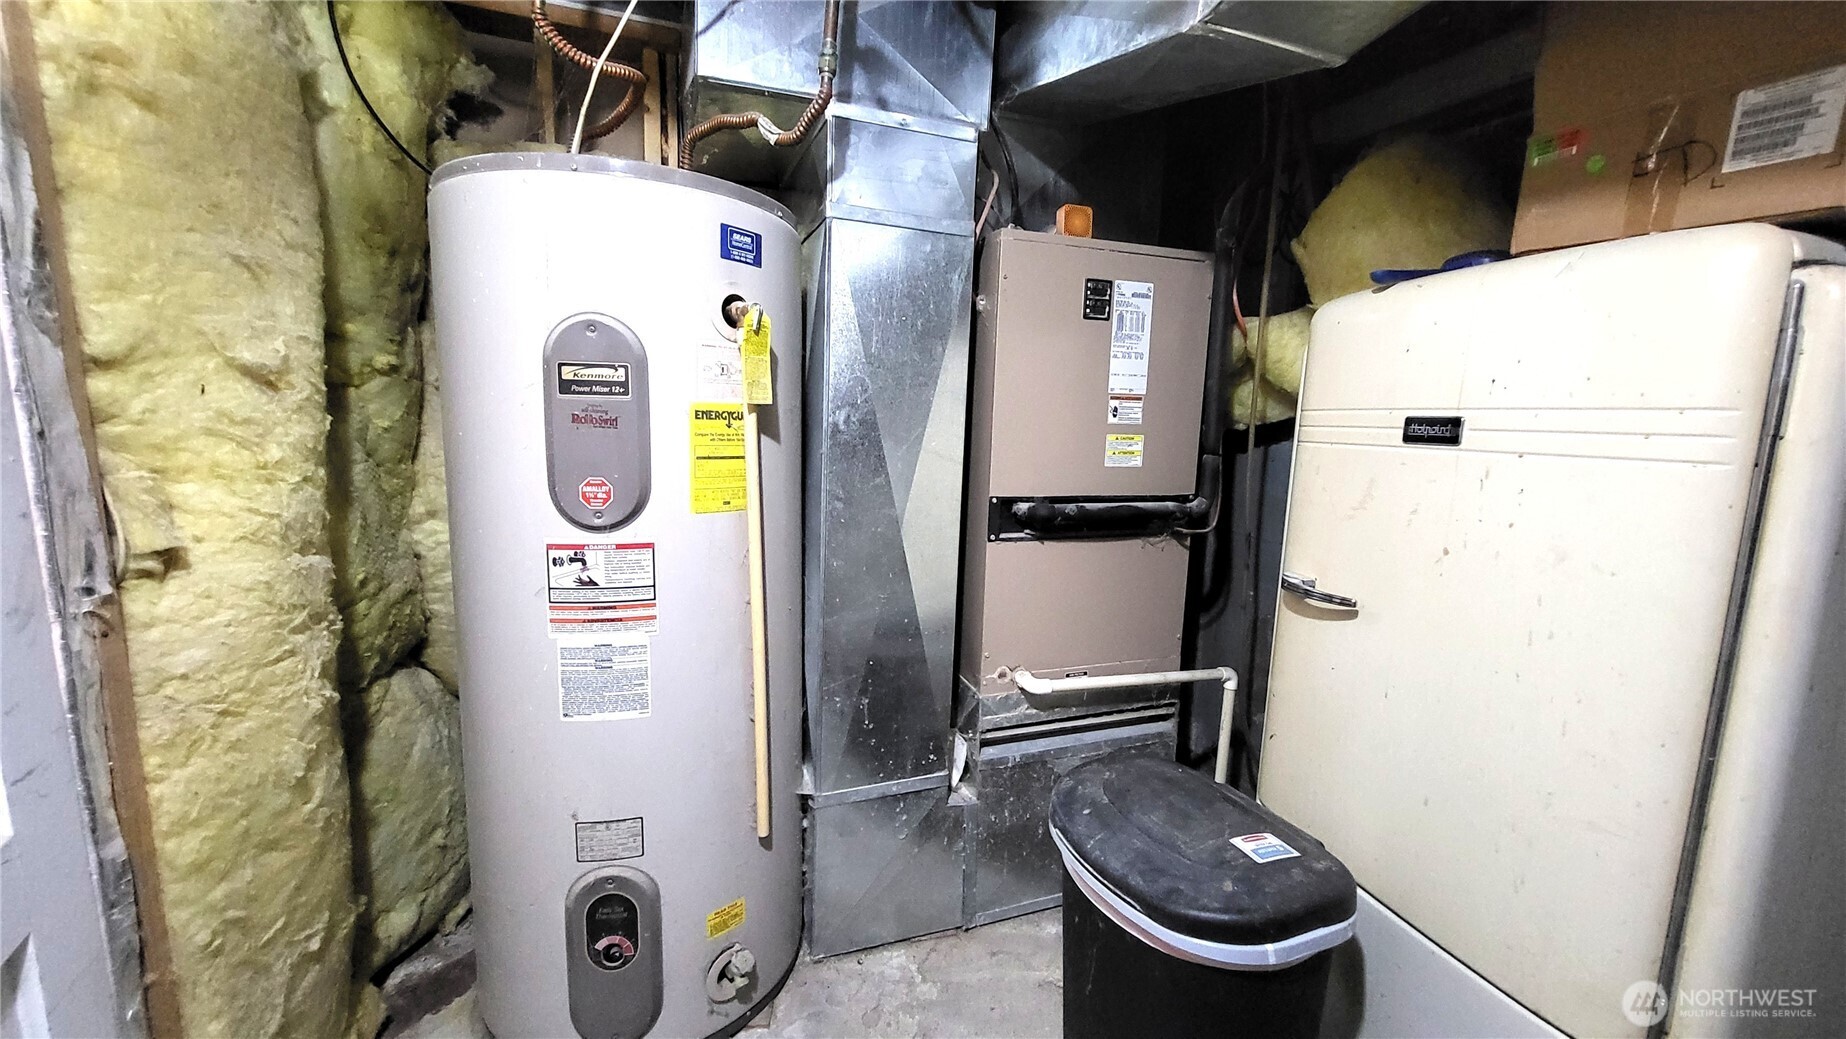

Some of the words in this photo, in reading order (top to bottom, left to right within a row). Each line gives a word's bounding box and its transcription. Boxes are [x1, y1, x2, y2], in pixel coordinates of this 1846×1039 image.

[732, 232, 752, 244] SEARS
[572, 371, 624, 380] Kenmore
[571, 384, 591, 393] Power
[592, 385, 610, 393] Miser
